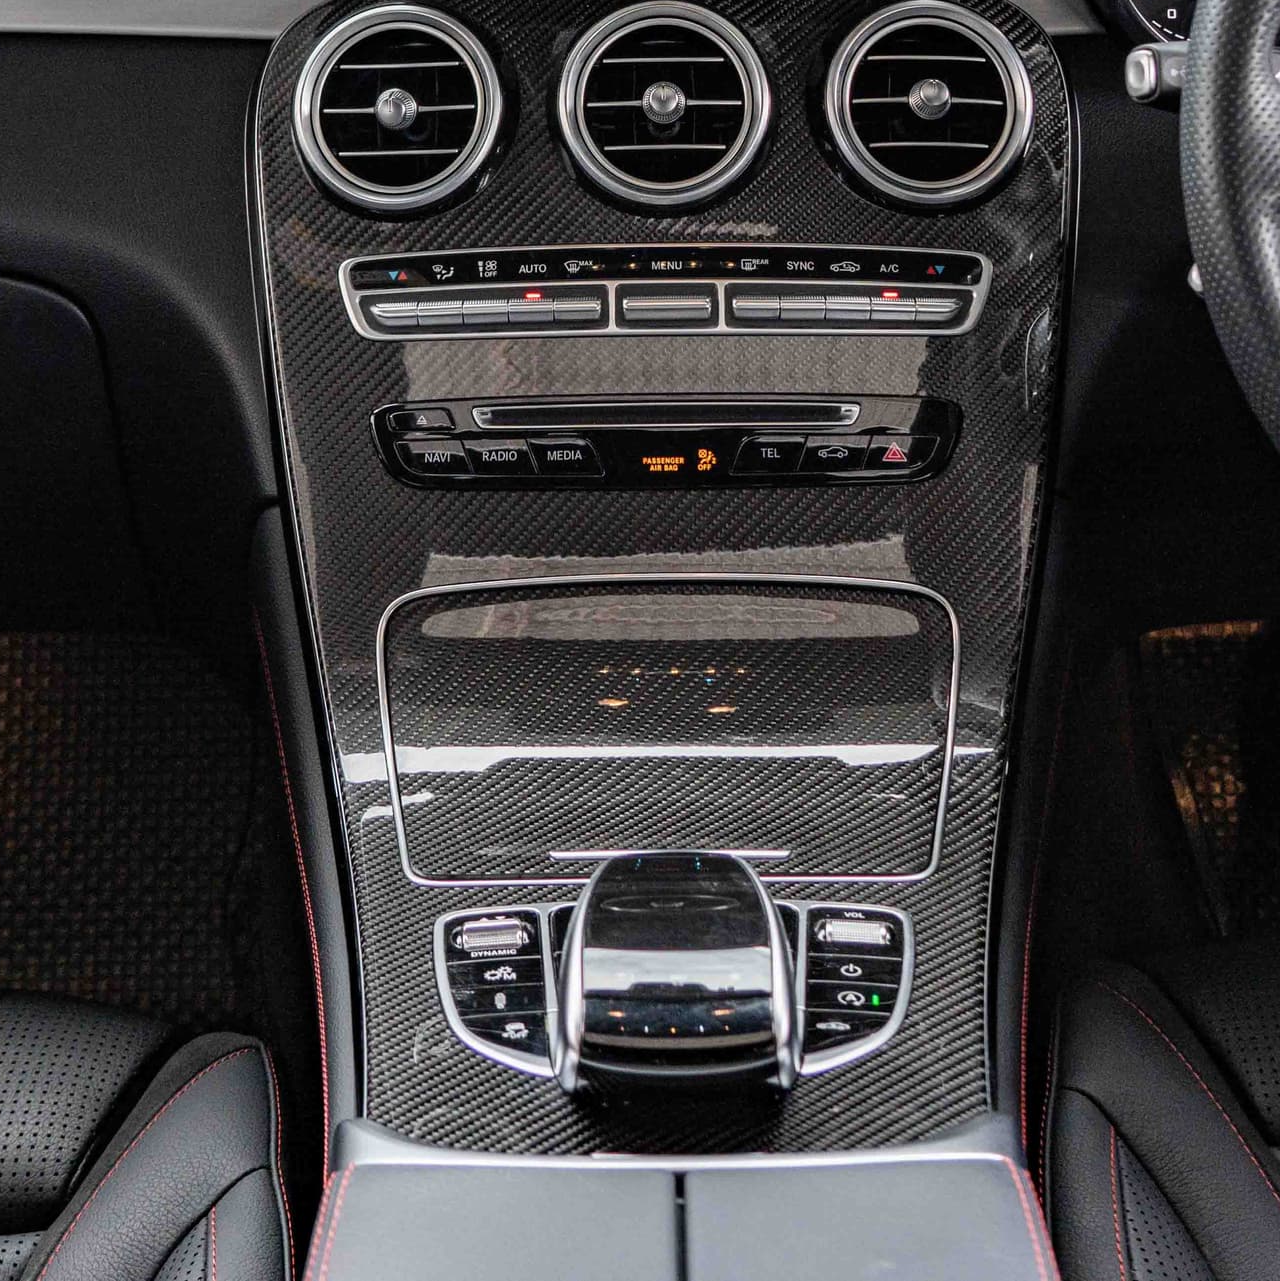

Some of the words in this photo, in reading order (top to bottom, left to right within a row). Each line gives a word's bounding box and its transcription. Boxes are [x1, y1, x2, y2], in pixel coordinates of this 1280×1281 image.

[1167, 8, 1177, 19] 0
[518, 263, 547, 274] AUTO
[651, 261, 683, 271] MENU
[786, 261, 815, 271] SYNC
[879, 264, 900, 273] A/C
[424, 452, 451, 463] NAVI
[482, 450, 518, 462] RADIO
[547, 450, 583, 461] MEDIA
[760, 447, 781, 458] TEL
[642, 457, 685, 465] PASSENGER
[649, 464, 663, 472] AIR
[697, 463, 712, 471] OFF
[844, 911, 866, 919] VOL
[470, 948, 517, 959] DYNAMIC
